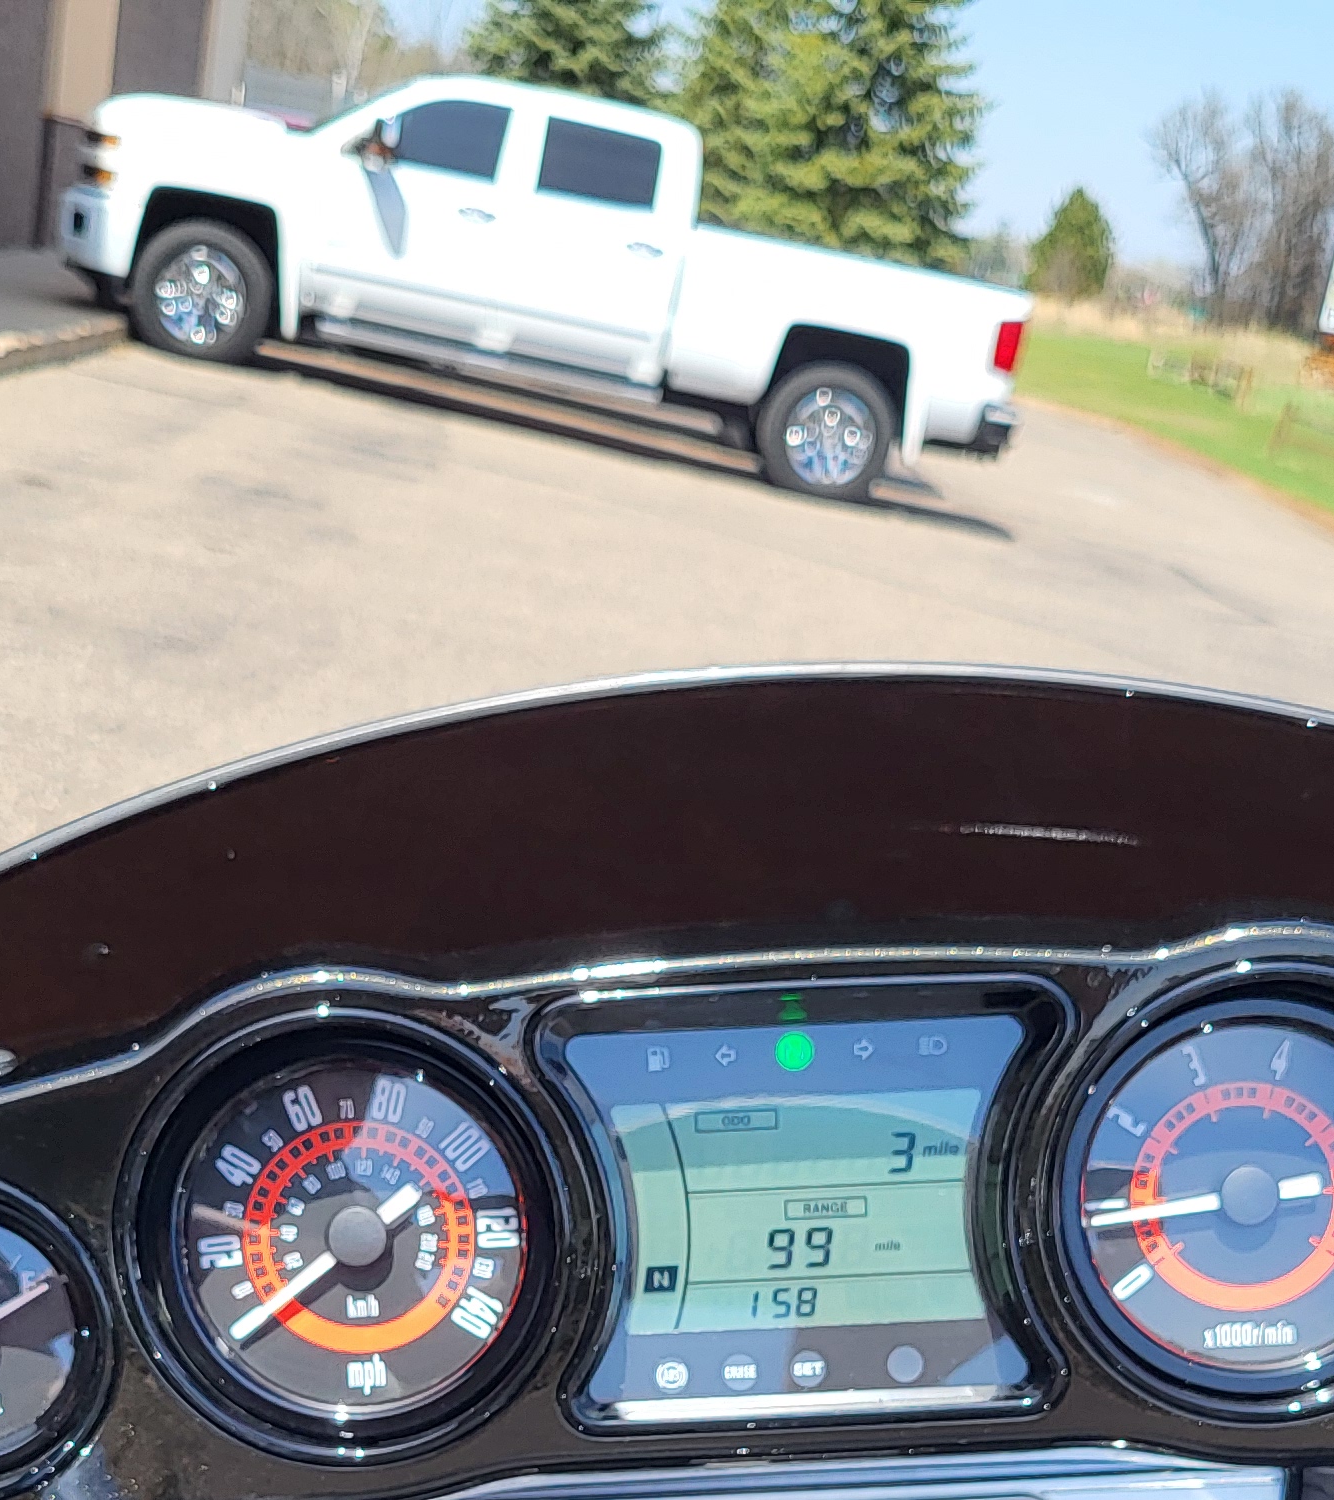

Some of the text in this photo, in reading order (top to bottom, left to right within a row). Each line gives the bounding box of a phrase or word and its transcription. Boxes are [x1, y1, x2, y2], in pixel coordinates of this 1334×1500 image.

[1181, 1045, 1206, 1087] 3
[1270, 1037, 1291, 1081] 4
[282, 1084, 322, 1132] 60
[338, 1097, 354, 1119] 70
[370, 1079, 407, 1122] 80
[721, 1115, 751, 1127] ODO
[1106, 1104, 1148, 1137] 2
[215, 1144, 261, 1187] 40
[439, 1122, 491, 1172] 100
[888, 1132, 961, 1174] 3 mile
[475, 1207, 520, 1248] 120
[802, 1201, 849, 1216] RANGE
[197, 1234, 244, 1269] 20
[767, 1226, 902, 1269] 99 mile
[651, 1270, 671, 1289] N
[1113, 1262, 1154, 1300] 0
[346, 1293, 380, 1319] km/h
[450, 1285, 504, 1340] 140
[1203, 1320, 1298, 1349] x1000r/min
[346, 1353, 387, 1396] mph
[793, 1361, 825, 1377] SET
